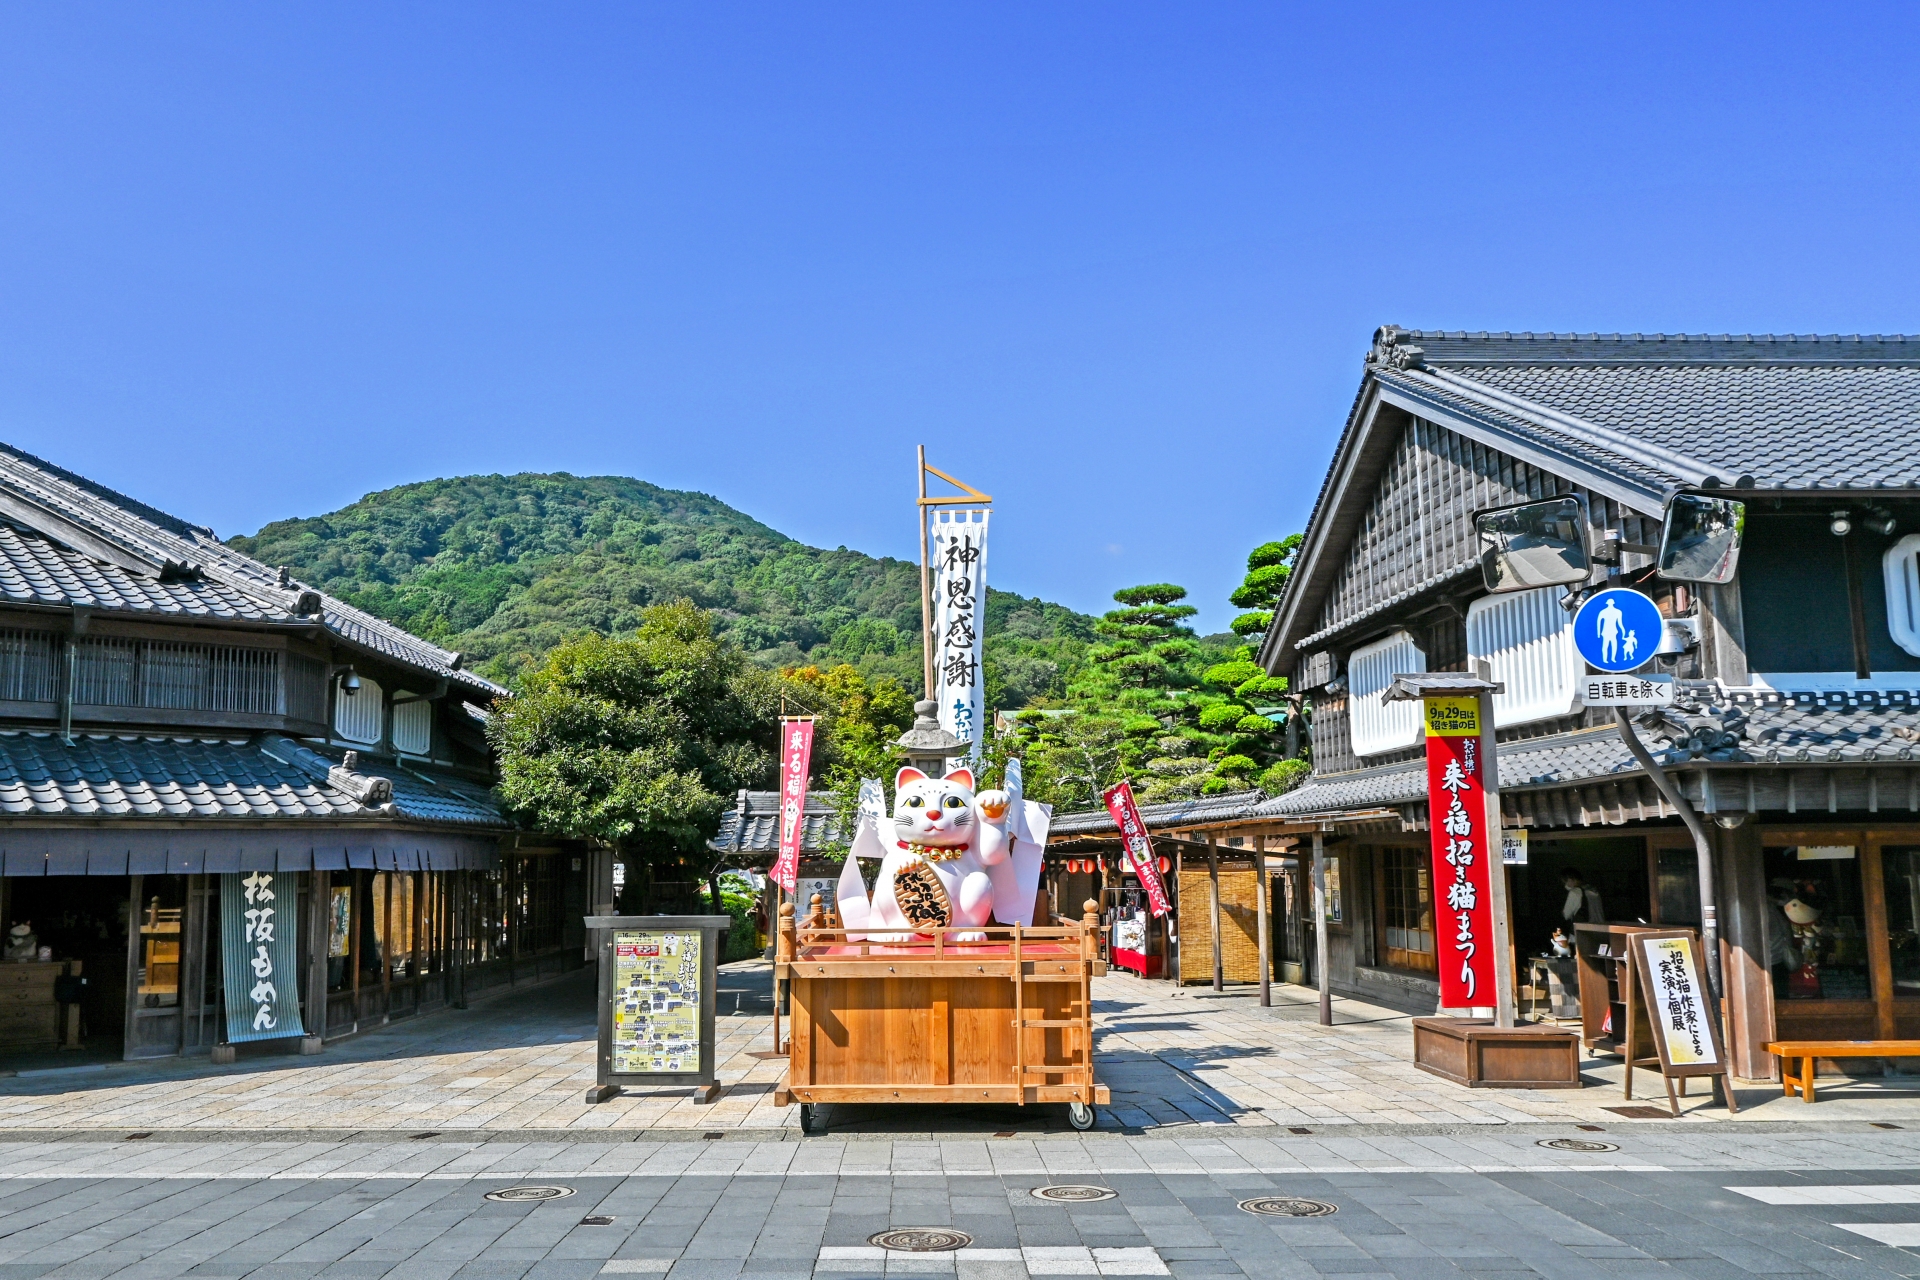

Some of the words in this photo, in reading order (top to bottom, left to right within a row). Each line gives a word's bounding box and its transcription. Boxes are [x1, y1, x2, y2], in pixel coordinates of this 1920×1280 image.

[942, 535, 980, 688] 神恩感謝
[1588, 681, 1664, 699] 自転車を除く
[1429, 707, 1475, 720] 9月29日は
[1431, 720, 1476, 731] 招き猫の日
[786, 730, 803, 796] 来る福
[1463, 738, 1476, 776] おかげ横丁
[1111, 792, 1138, 835] 来る福
[781, 845, 795, 888] 招き猫
[242, 871, 277, 1031] 松阪もめん
[1658, 960, 1686, 1031] 実演と個展
[1669, 950, 1703, 1056] 招き猫作家による
